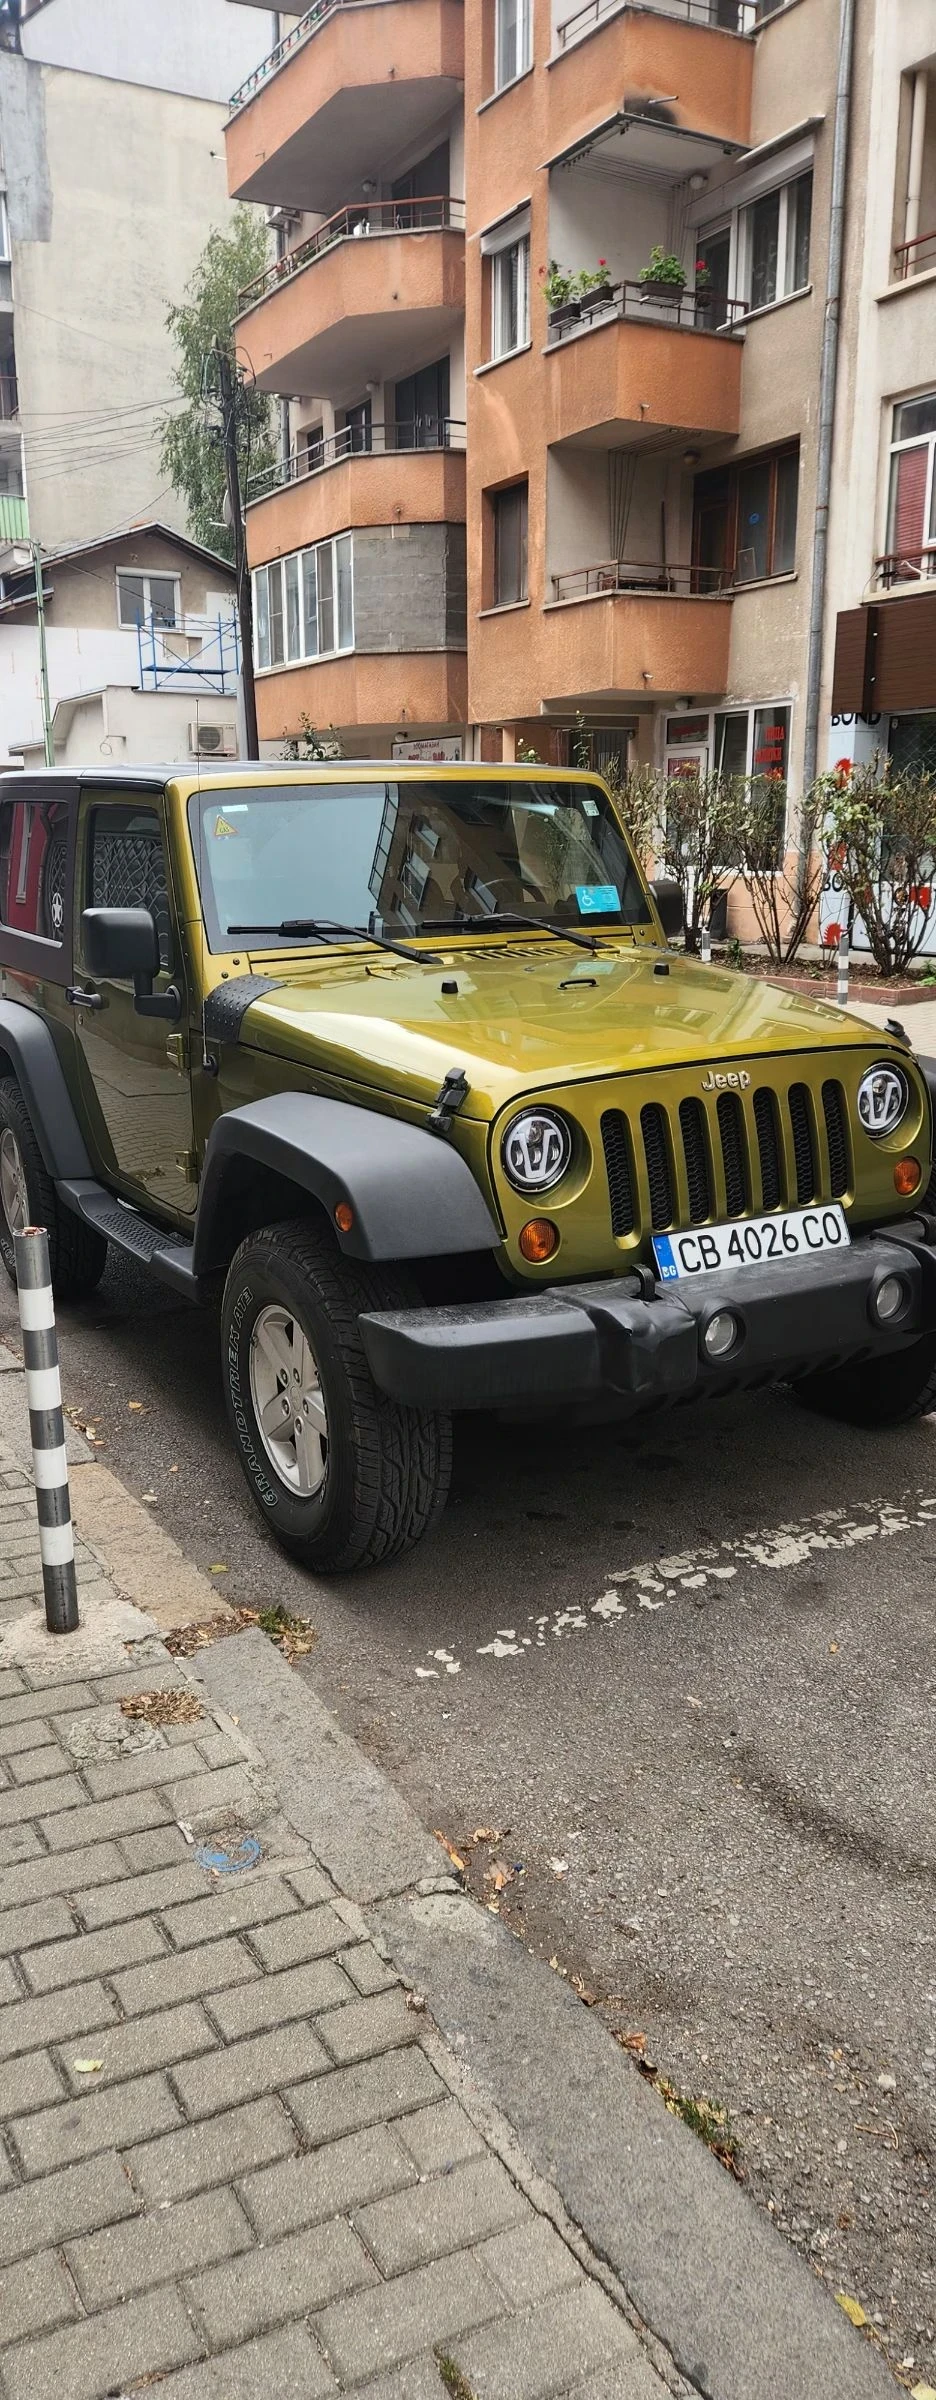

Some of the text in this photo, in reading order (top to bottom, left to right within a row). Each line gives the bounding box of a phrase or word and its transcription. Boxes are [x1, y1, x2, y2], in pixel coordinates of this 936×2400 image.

[831, 711, 880, 727] BOND
[701, 1071, 751, 1091] Jeep
[678, 1212, 842, 1273] CB 4026 CO
[662, 1265, 677, 1278] BG
[229, 1324, 278, 1506] GRANDTREK
